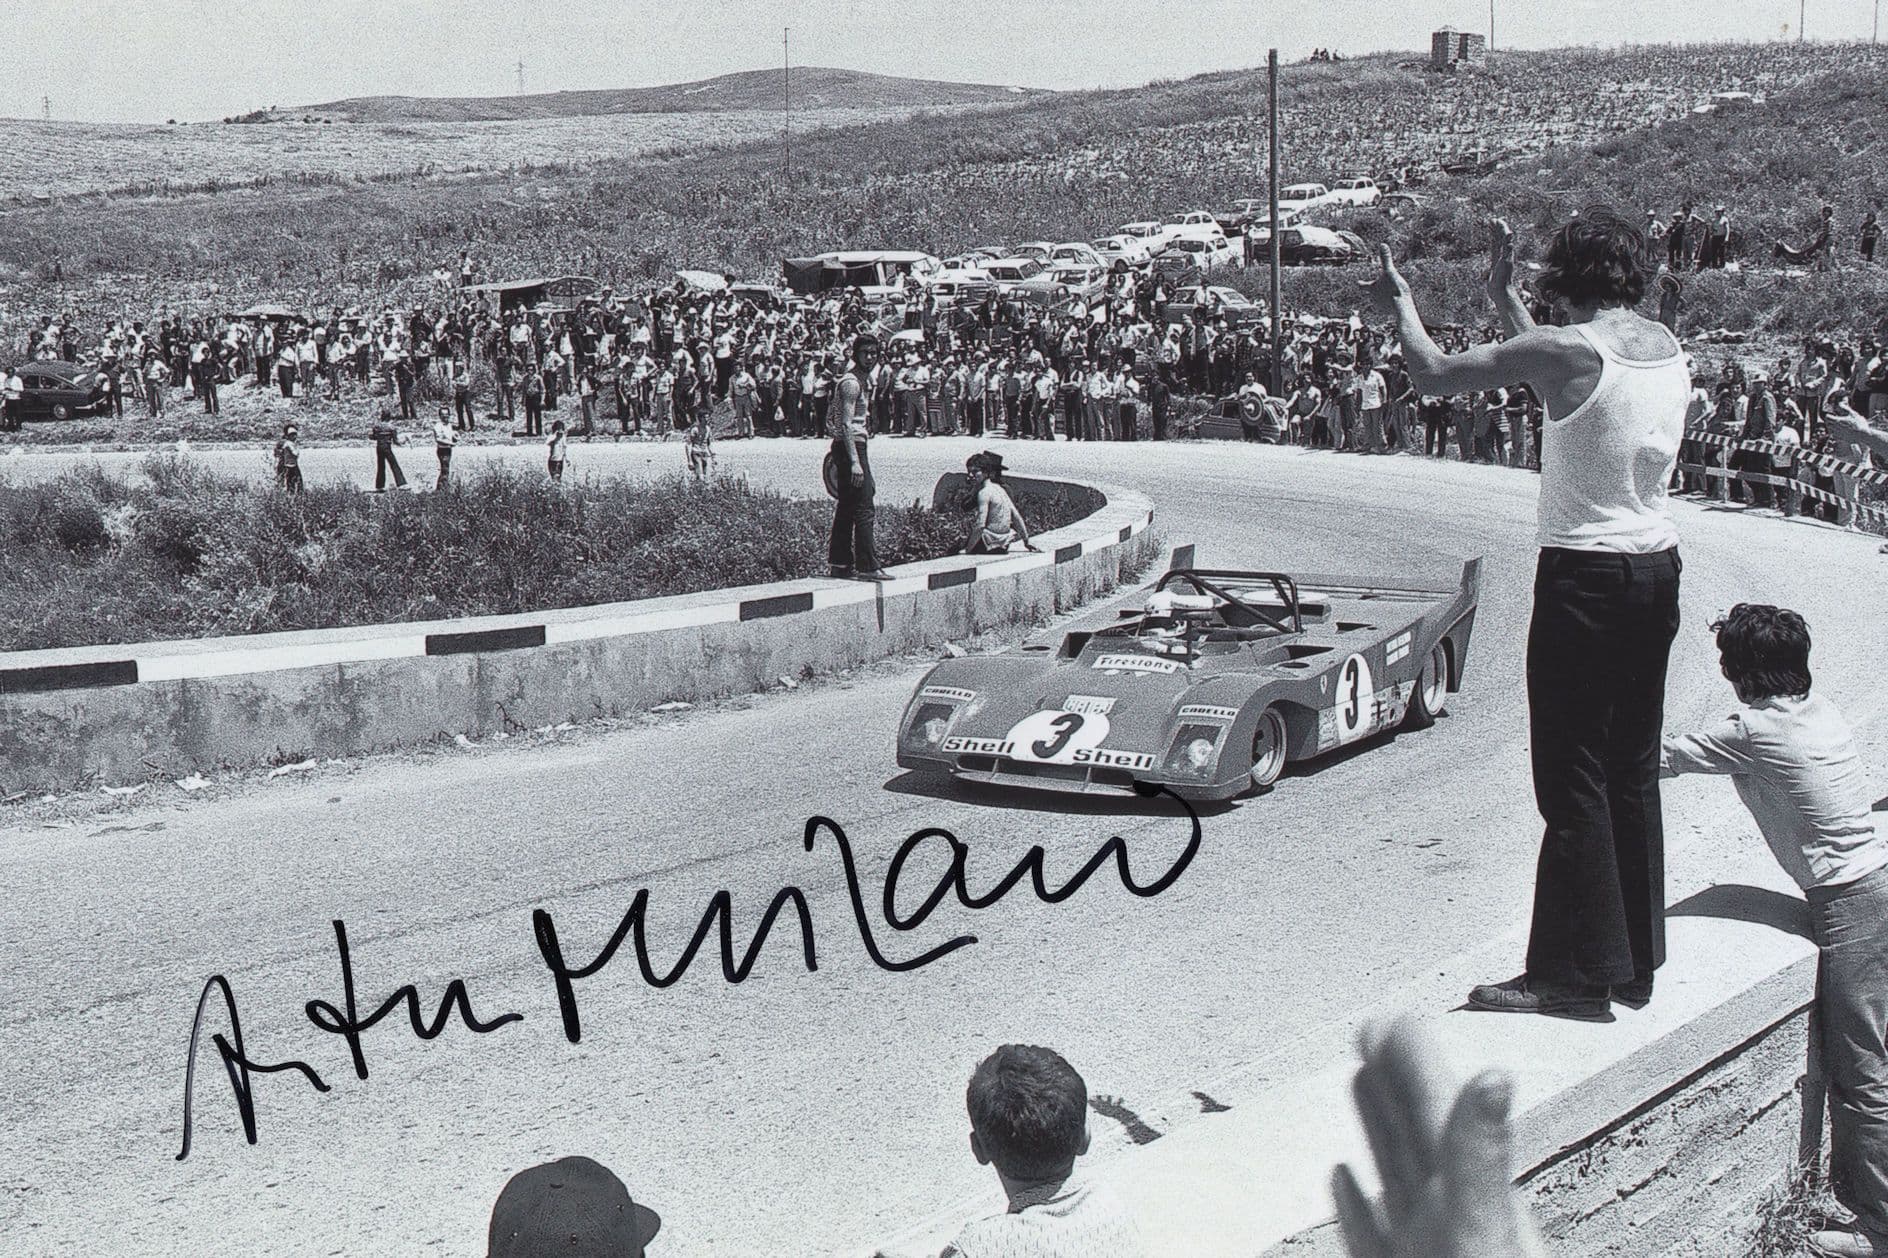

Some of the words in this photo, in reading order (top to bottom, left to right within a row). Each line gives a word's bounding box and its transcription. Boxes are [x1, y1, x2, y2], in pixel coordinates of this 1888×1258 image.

[1100, 656, 1173, 670] Firestone
[1344, 658, 1359, 730] 3
[944, 737, 1015, 754] Shell
[1031, 713, 1085, 759] 3
[1072, 748, 1154, 769] Shell
